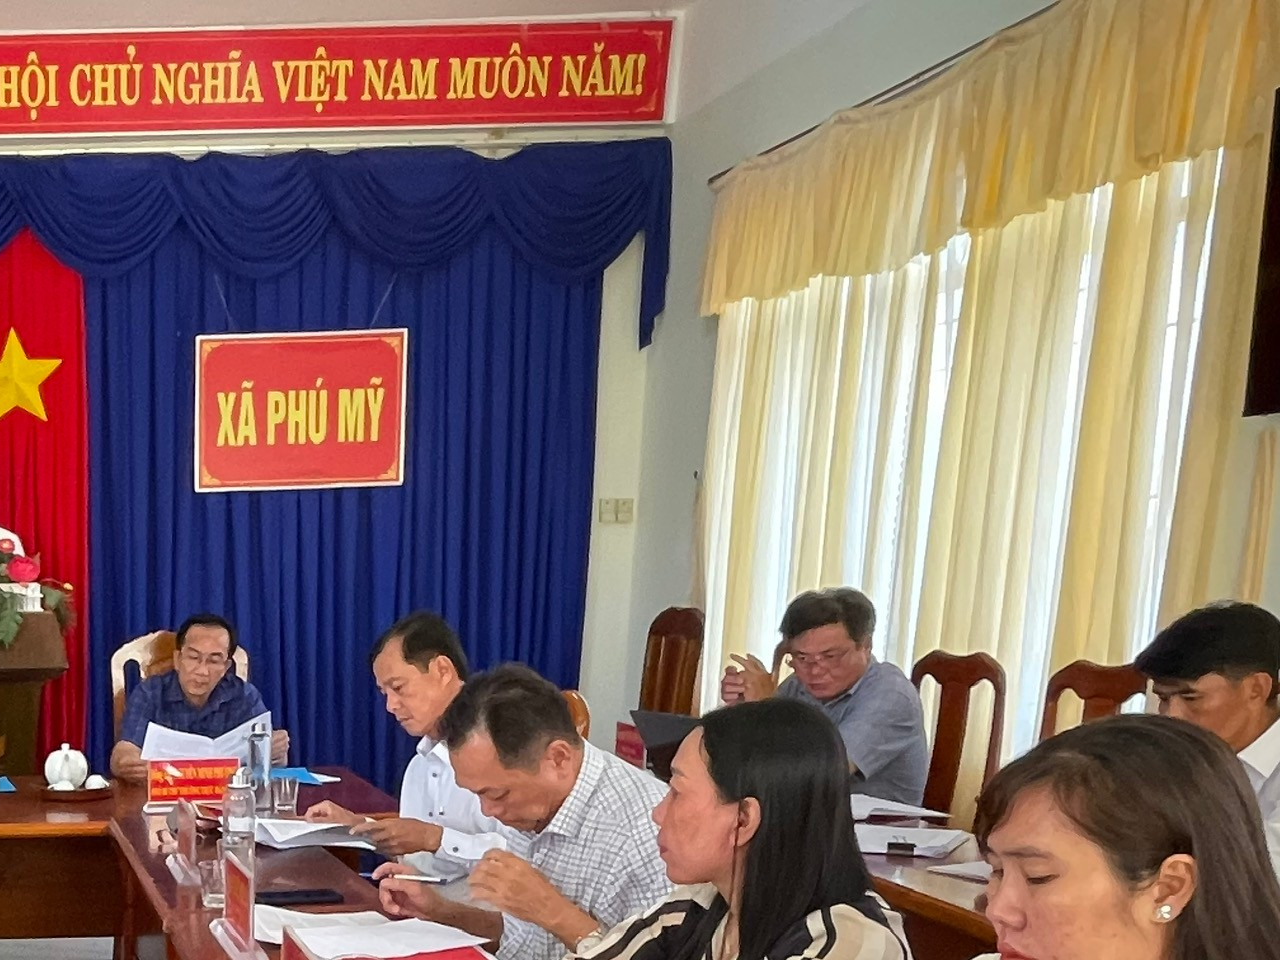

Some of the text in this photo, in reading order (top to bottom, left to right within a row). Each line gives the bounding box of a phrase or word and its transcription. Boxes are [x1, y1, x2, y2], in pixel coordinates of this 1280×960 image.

[70, 45, 143, 107] CHỦ
[152, 49, 264, 105] NGHĨA
[272, 46, 354, 113] VIỆT
[363, 57, 438, 101] NAM
[448, 42, 552, 99] MUÔN
[558, 42, 646, 97] NĂM!
[216, 376, 385, 447] XÃ PHÚ MỸ
